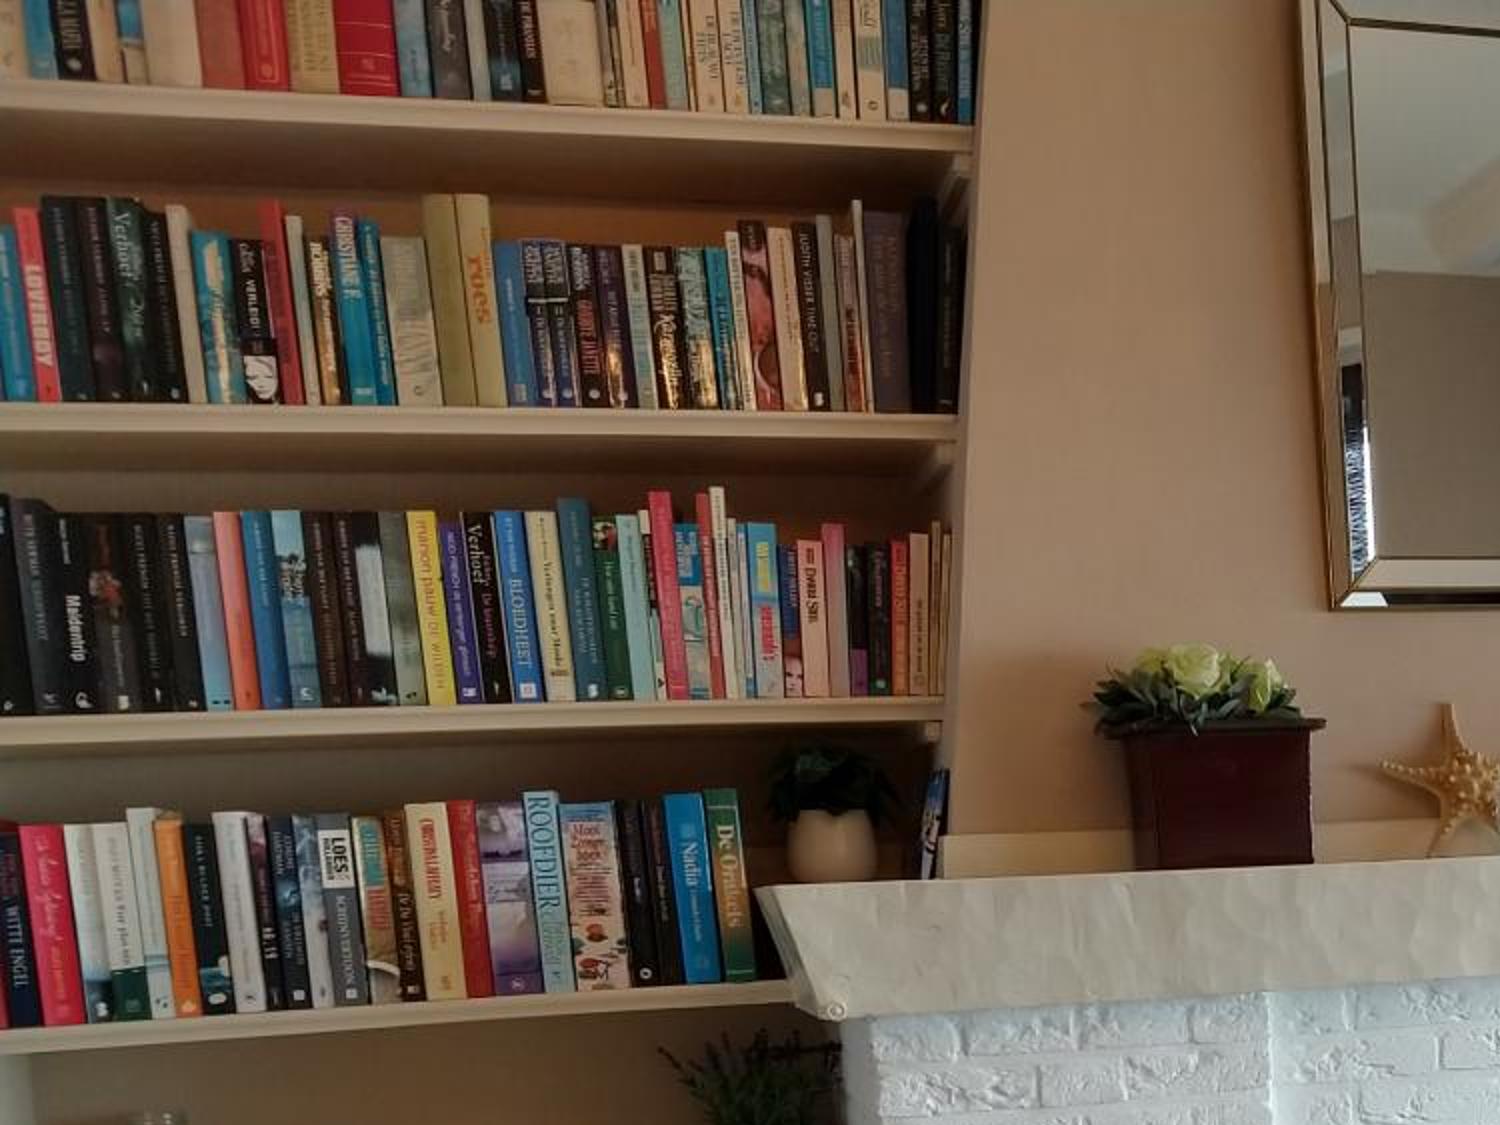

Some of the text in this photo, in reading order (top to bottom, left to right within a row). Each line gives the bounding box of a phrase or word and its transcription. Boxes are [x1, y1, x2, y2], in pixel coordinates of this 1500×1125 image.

[799, 233, 811, 267] JUDITH
[803, 271, 815, 303] VISSER
[25, 264, 52, 367] LOVERBOY
[807, 306, 817, 328] TIME
[420, 576, 440, 617] pauw
[331, 837, 349, 873] LOES
[528, 797, 561, 910] ROOFDIER
[717, 825, 735, 850] De
[682, 841, 702, 886] Nadia
